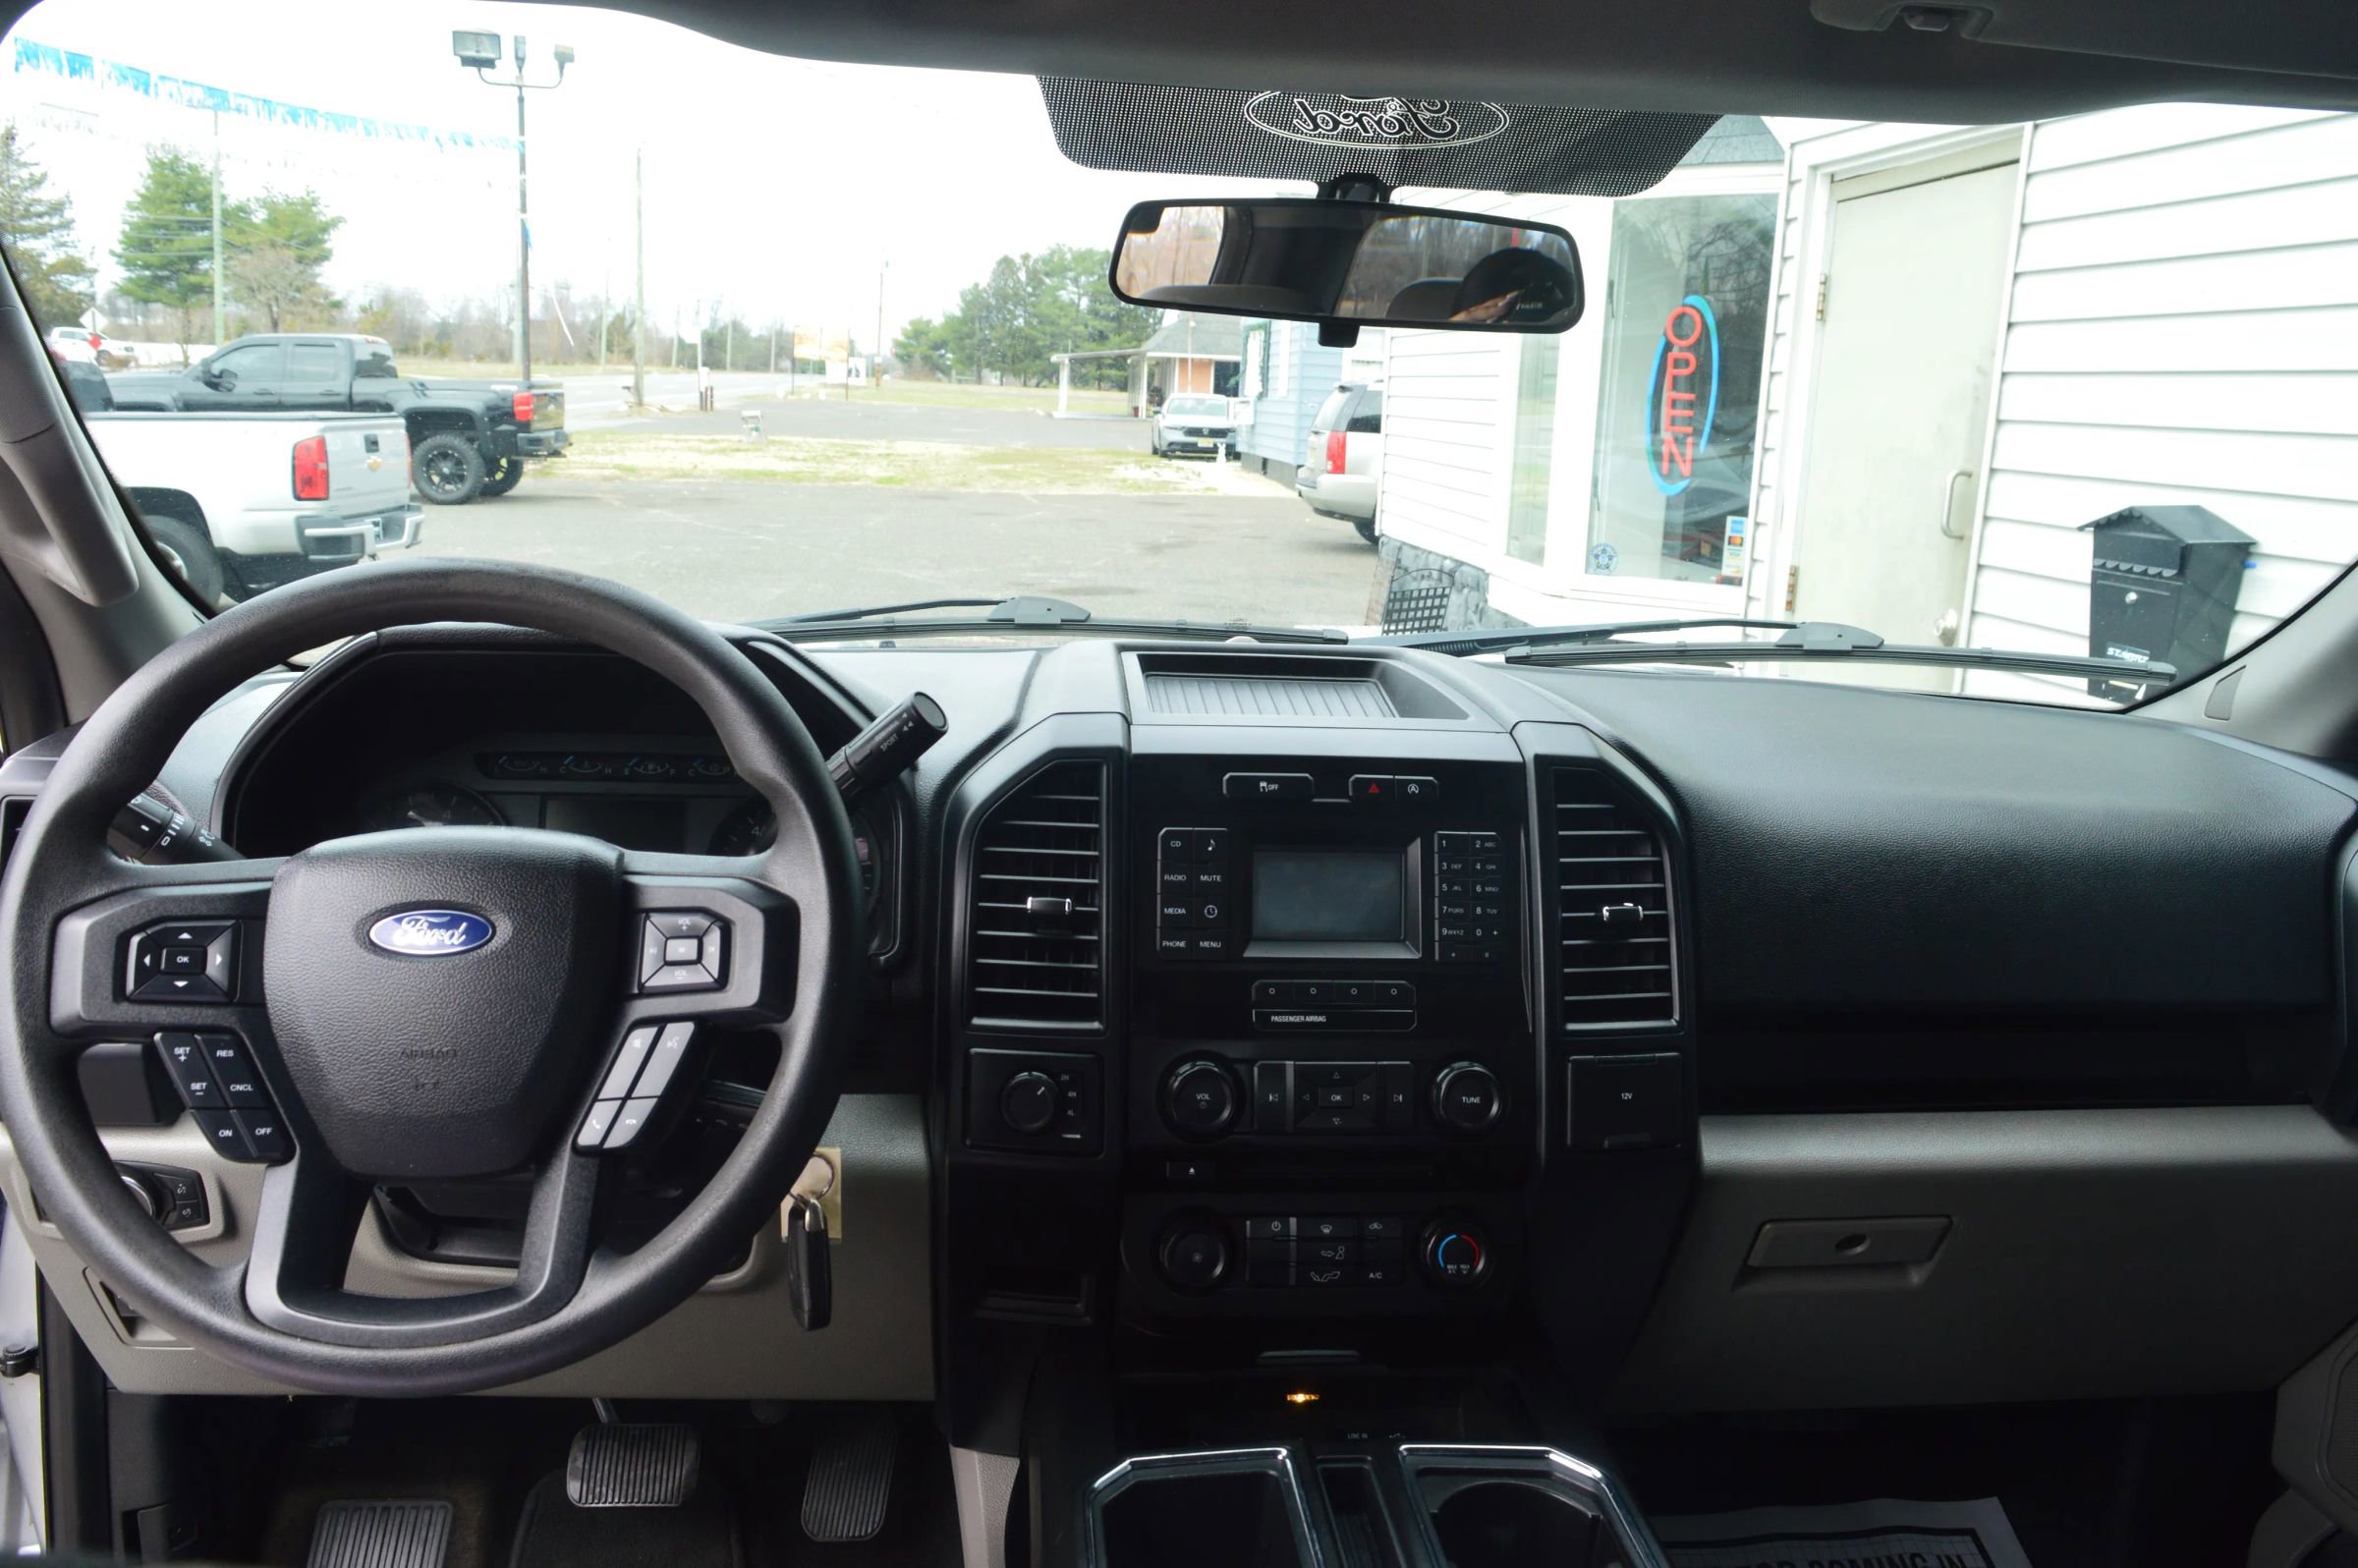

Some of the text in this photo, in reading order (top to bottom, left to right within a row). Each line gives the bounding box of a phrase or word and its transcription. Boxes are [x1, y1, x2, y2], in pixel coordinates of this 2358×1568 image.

[1661, 306, 1703, 476] OPEN
[1441, 862, 1447, 870] 3
[391, 916, 467, 945] Ford
[174, 1046, 191, 1055] SET
[218, 1129, 233, 1138] ON
[254, 1127, 273, 1136] OFF
